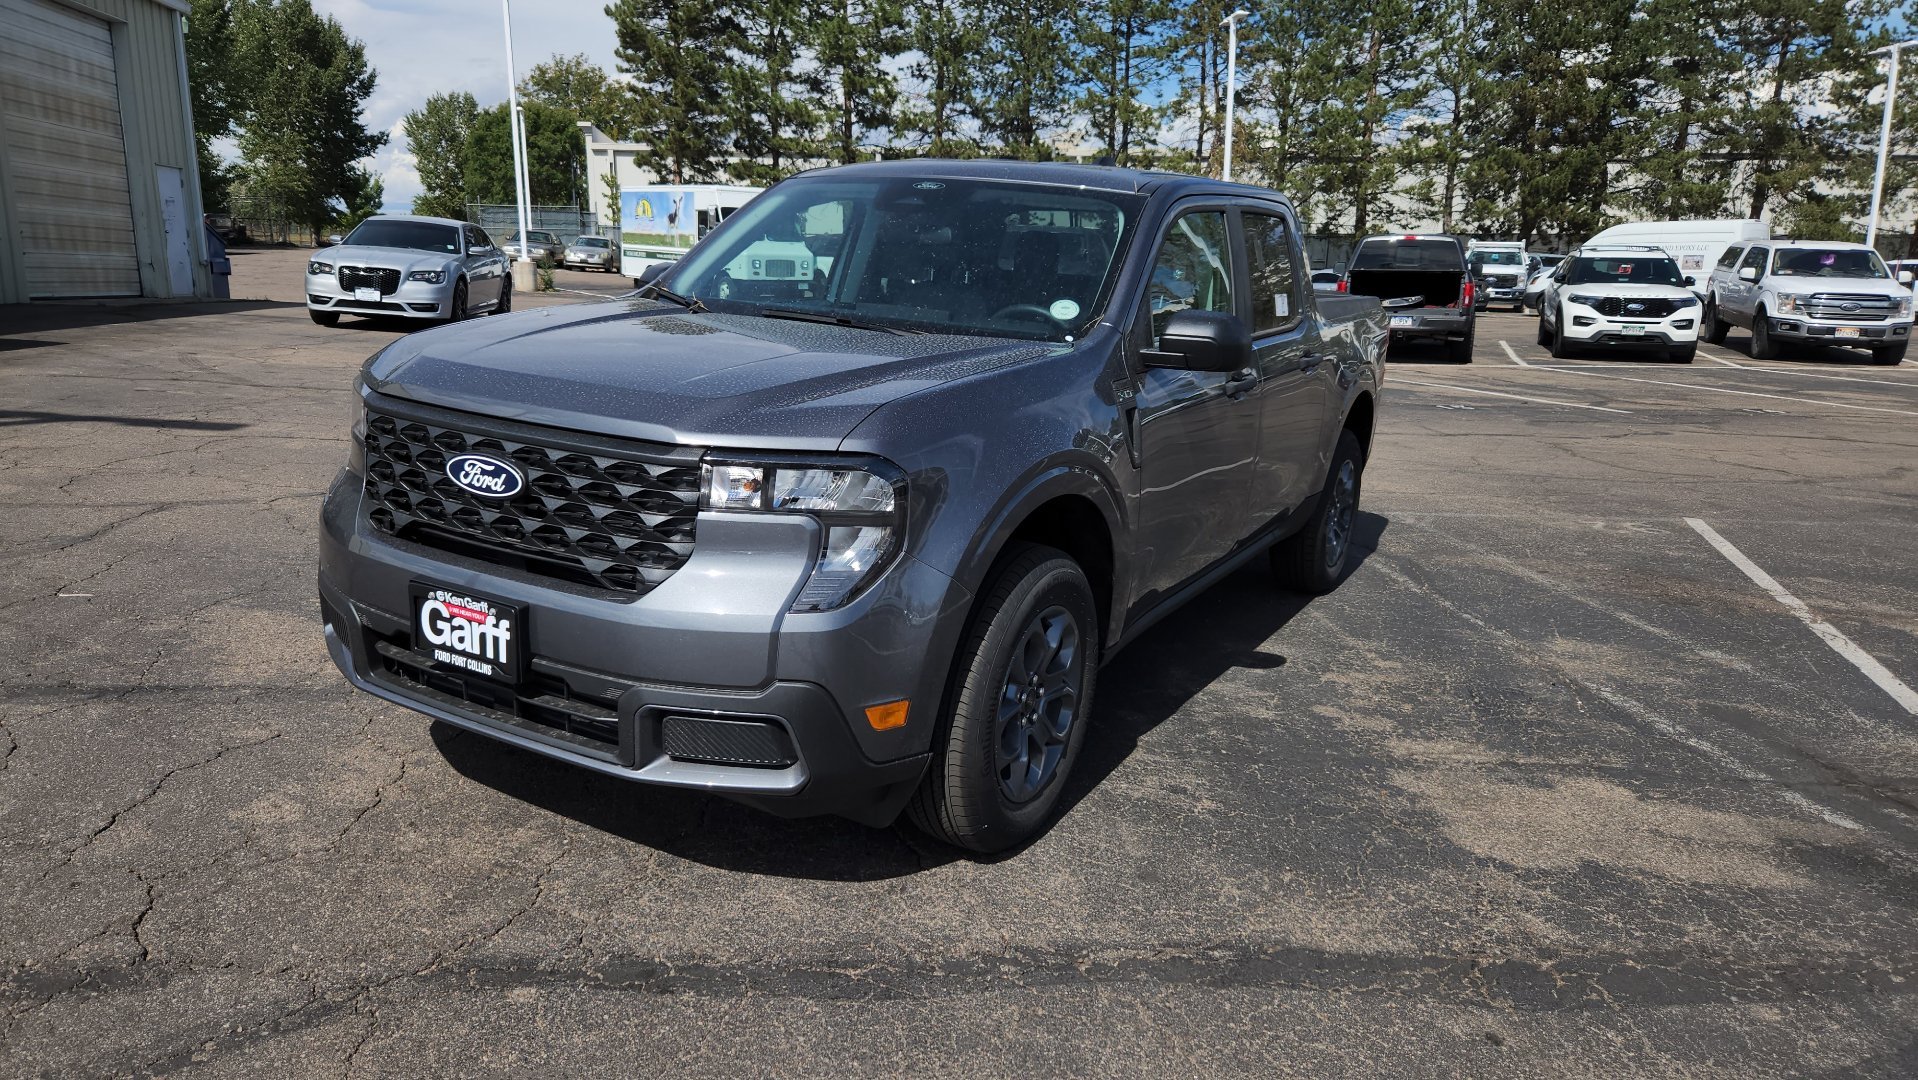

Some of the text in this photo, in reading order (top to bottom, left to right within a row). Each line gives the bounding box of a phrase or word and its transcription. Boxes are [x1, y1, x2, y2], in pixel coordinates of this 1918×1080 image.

[460, 460, 506, 491] Ford
[421, 600, 510, 664] Garff
[434, 650, 492, 675] FORD FORT COLLINS
